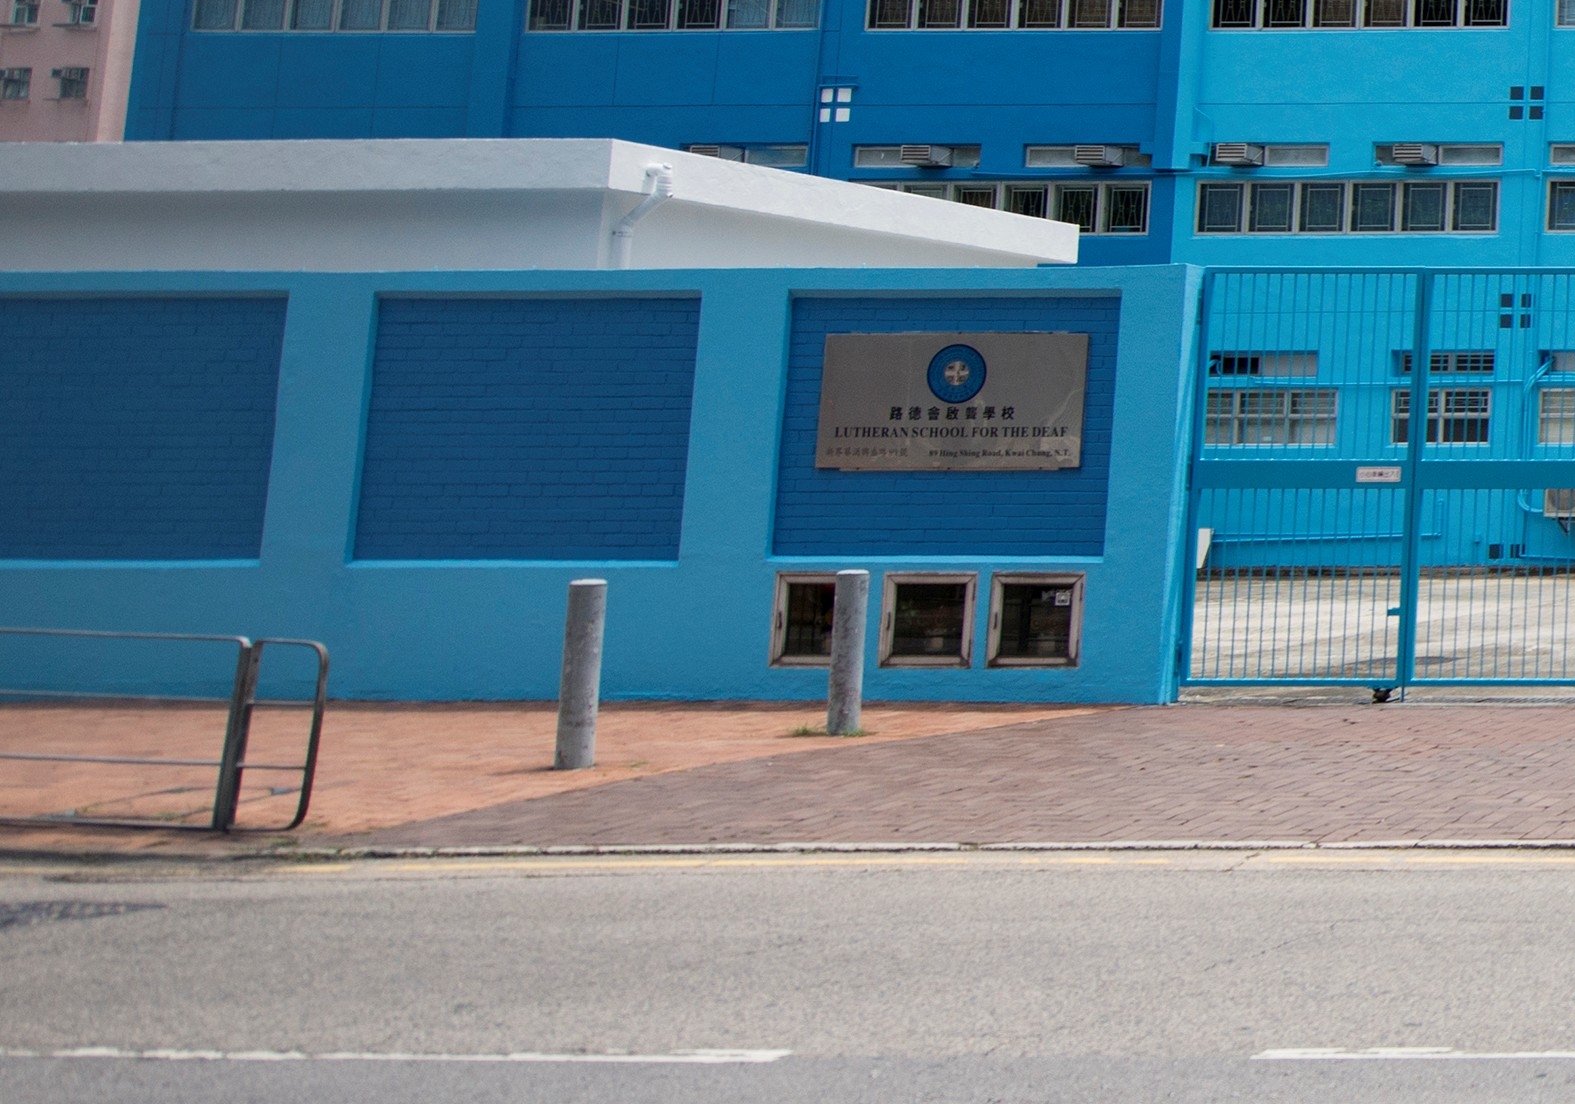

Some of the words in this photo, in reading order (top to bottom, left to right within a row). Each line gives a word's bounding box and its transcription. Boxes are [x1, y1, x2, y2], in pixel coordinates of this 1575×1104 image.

[889, 406, 1015, 421] 路德會啟聾學校
[835, 427, 908, 438] LUTHERAN
[911, 427, 968, 438] SCHOOL
[972, 427, 999, 438] FOR
[1002, 427, 1029, 438] THE
[1032, 426, 1068, 437] DEAF
